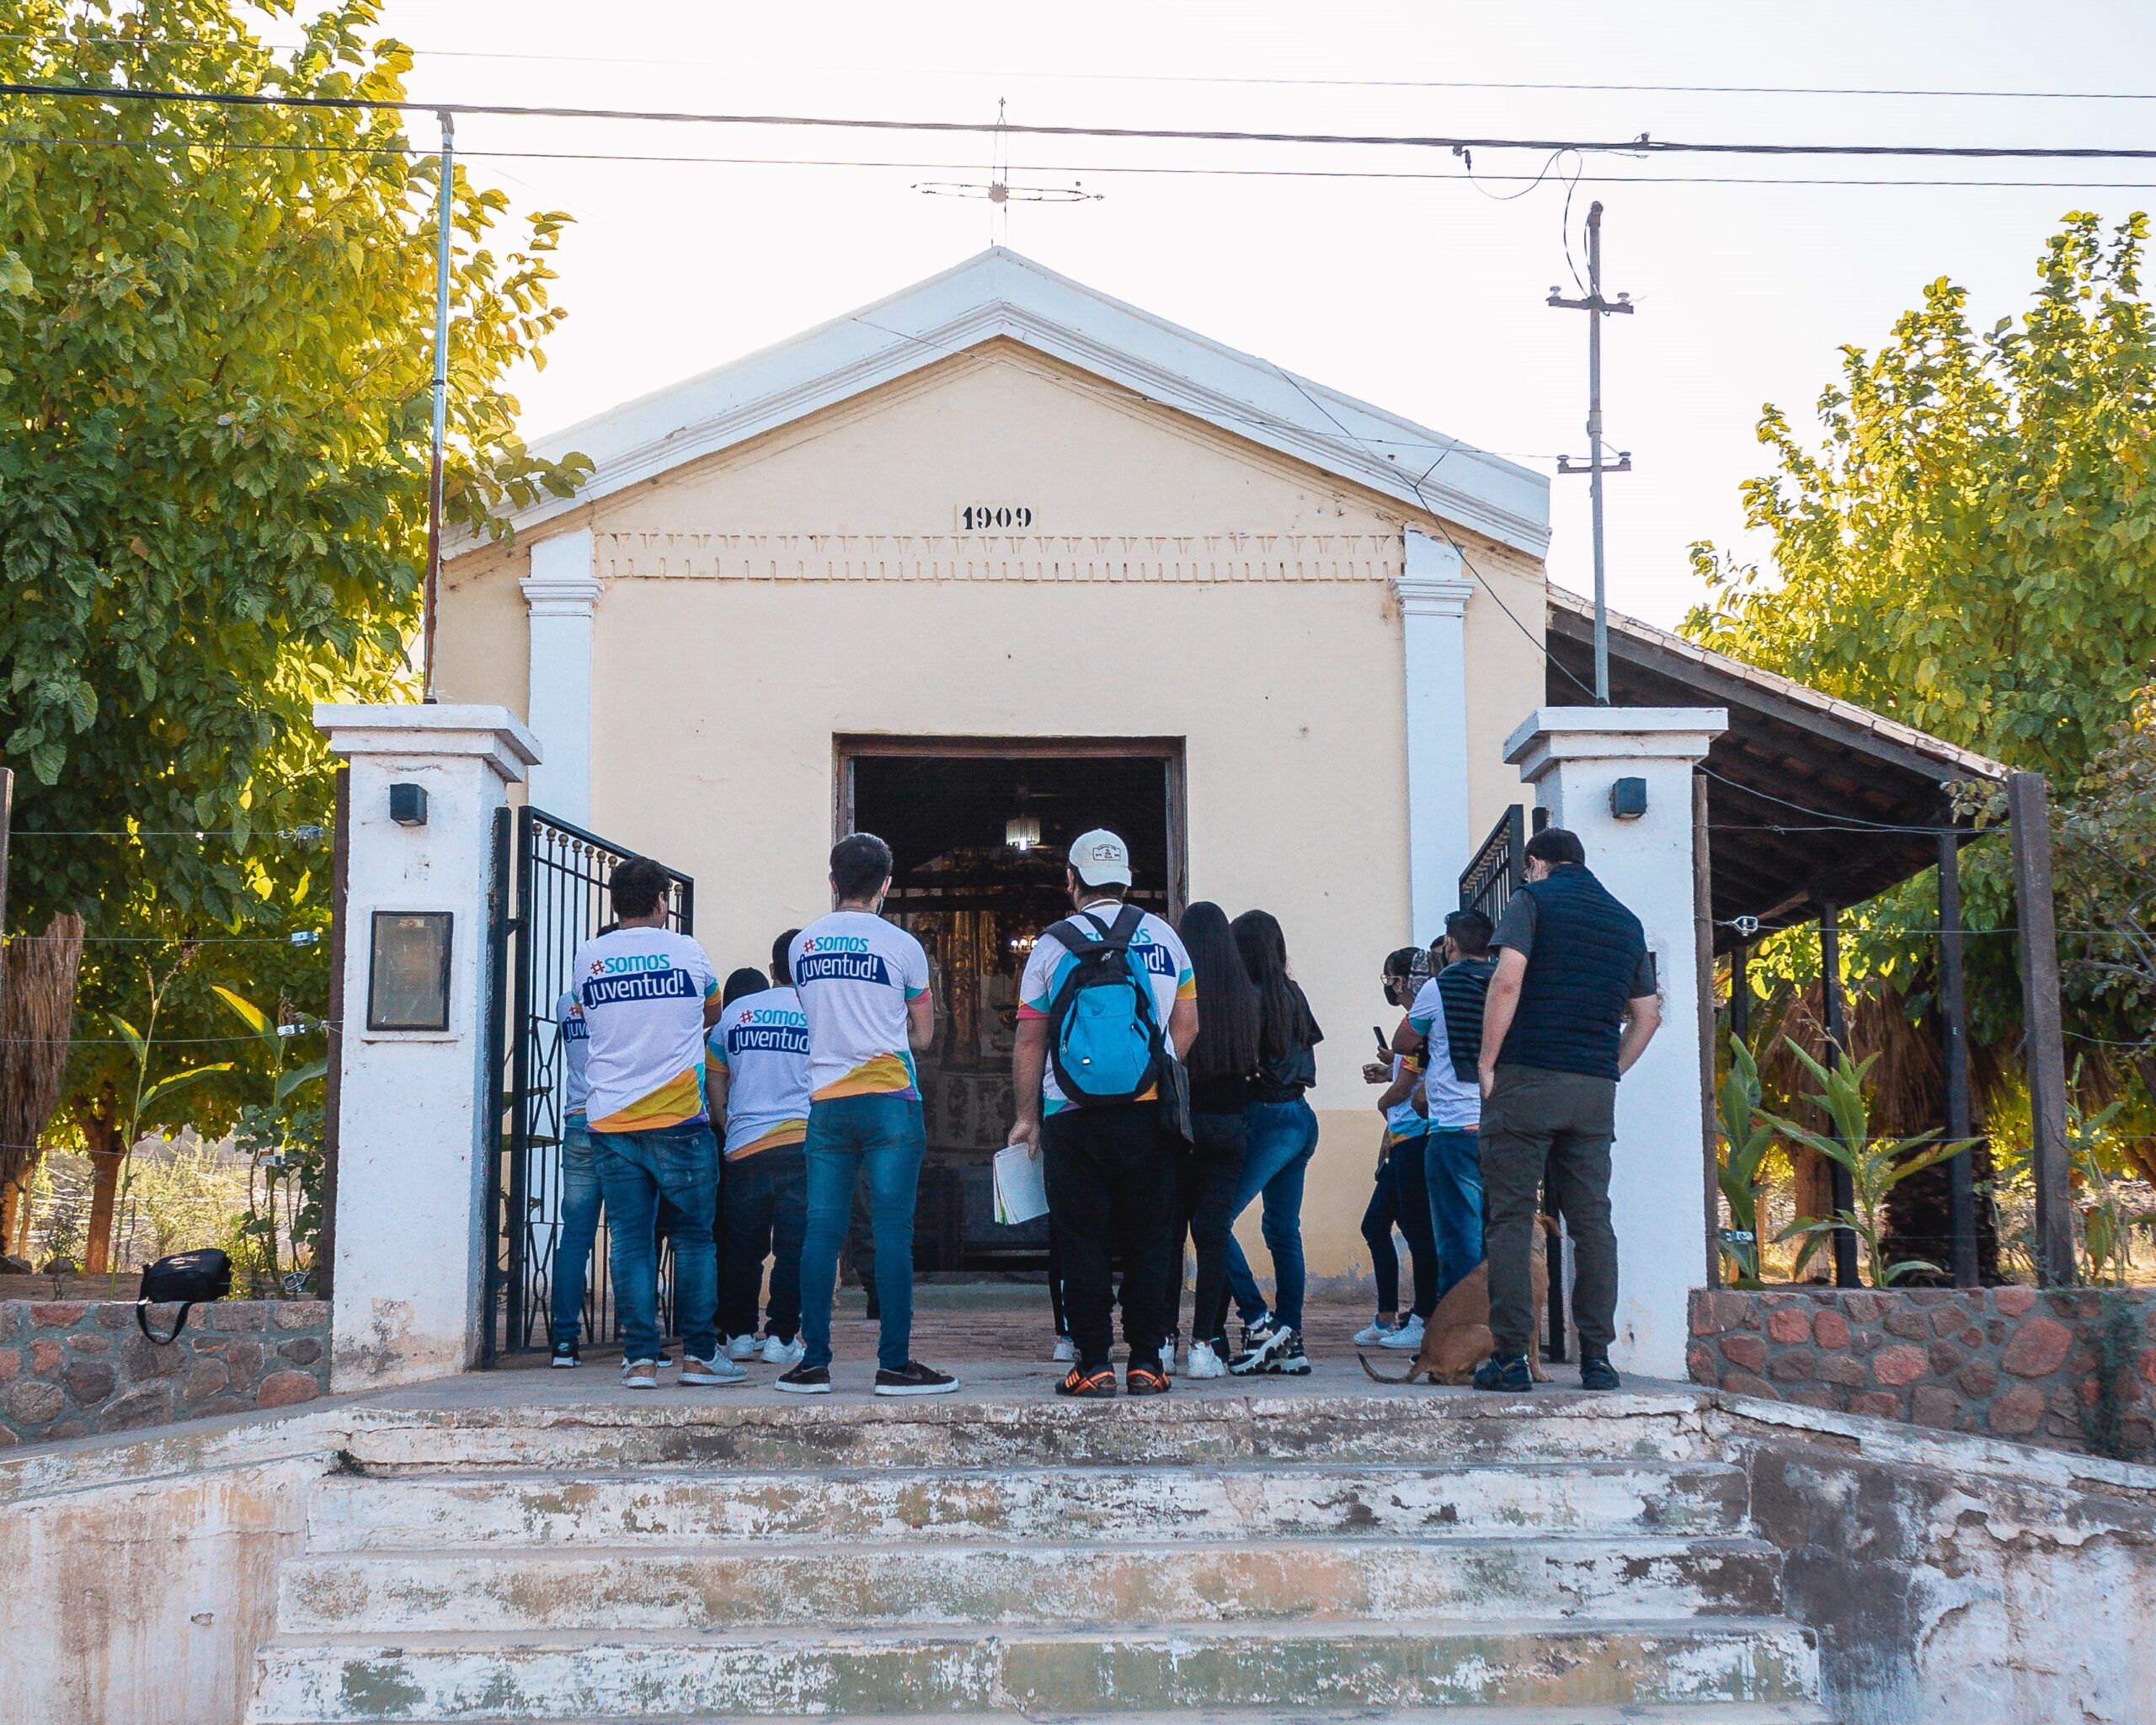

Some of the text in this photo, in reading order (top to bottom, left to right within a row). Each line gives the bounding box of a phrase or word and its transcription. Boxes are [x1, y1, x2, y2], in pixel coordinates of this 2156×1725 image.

[963, 506, 1032, 530] 1909
[803, 936, 869, 953] #somos
[590, 953, 670, 975] #somos
[800, 953, 878, 985] juventud!
[589, 969, 685, 1009] juventud!
[740, 1009, 808, 1028] #somos
